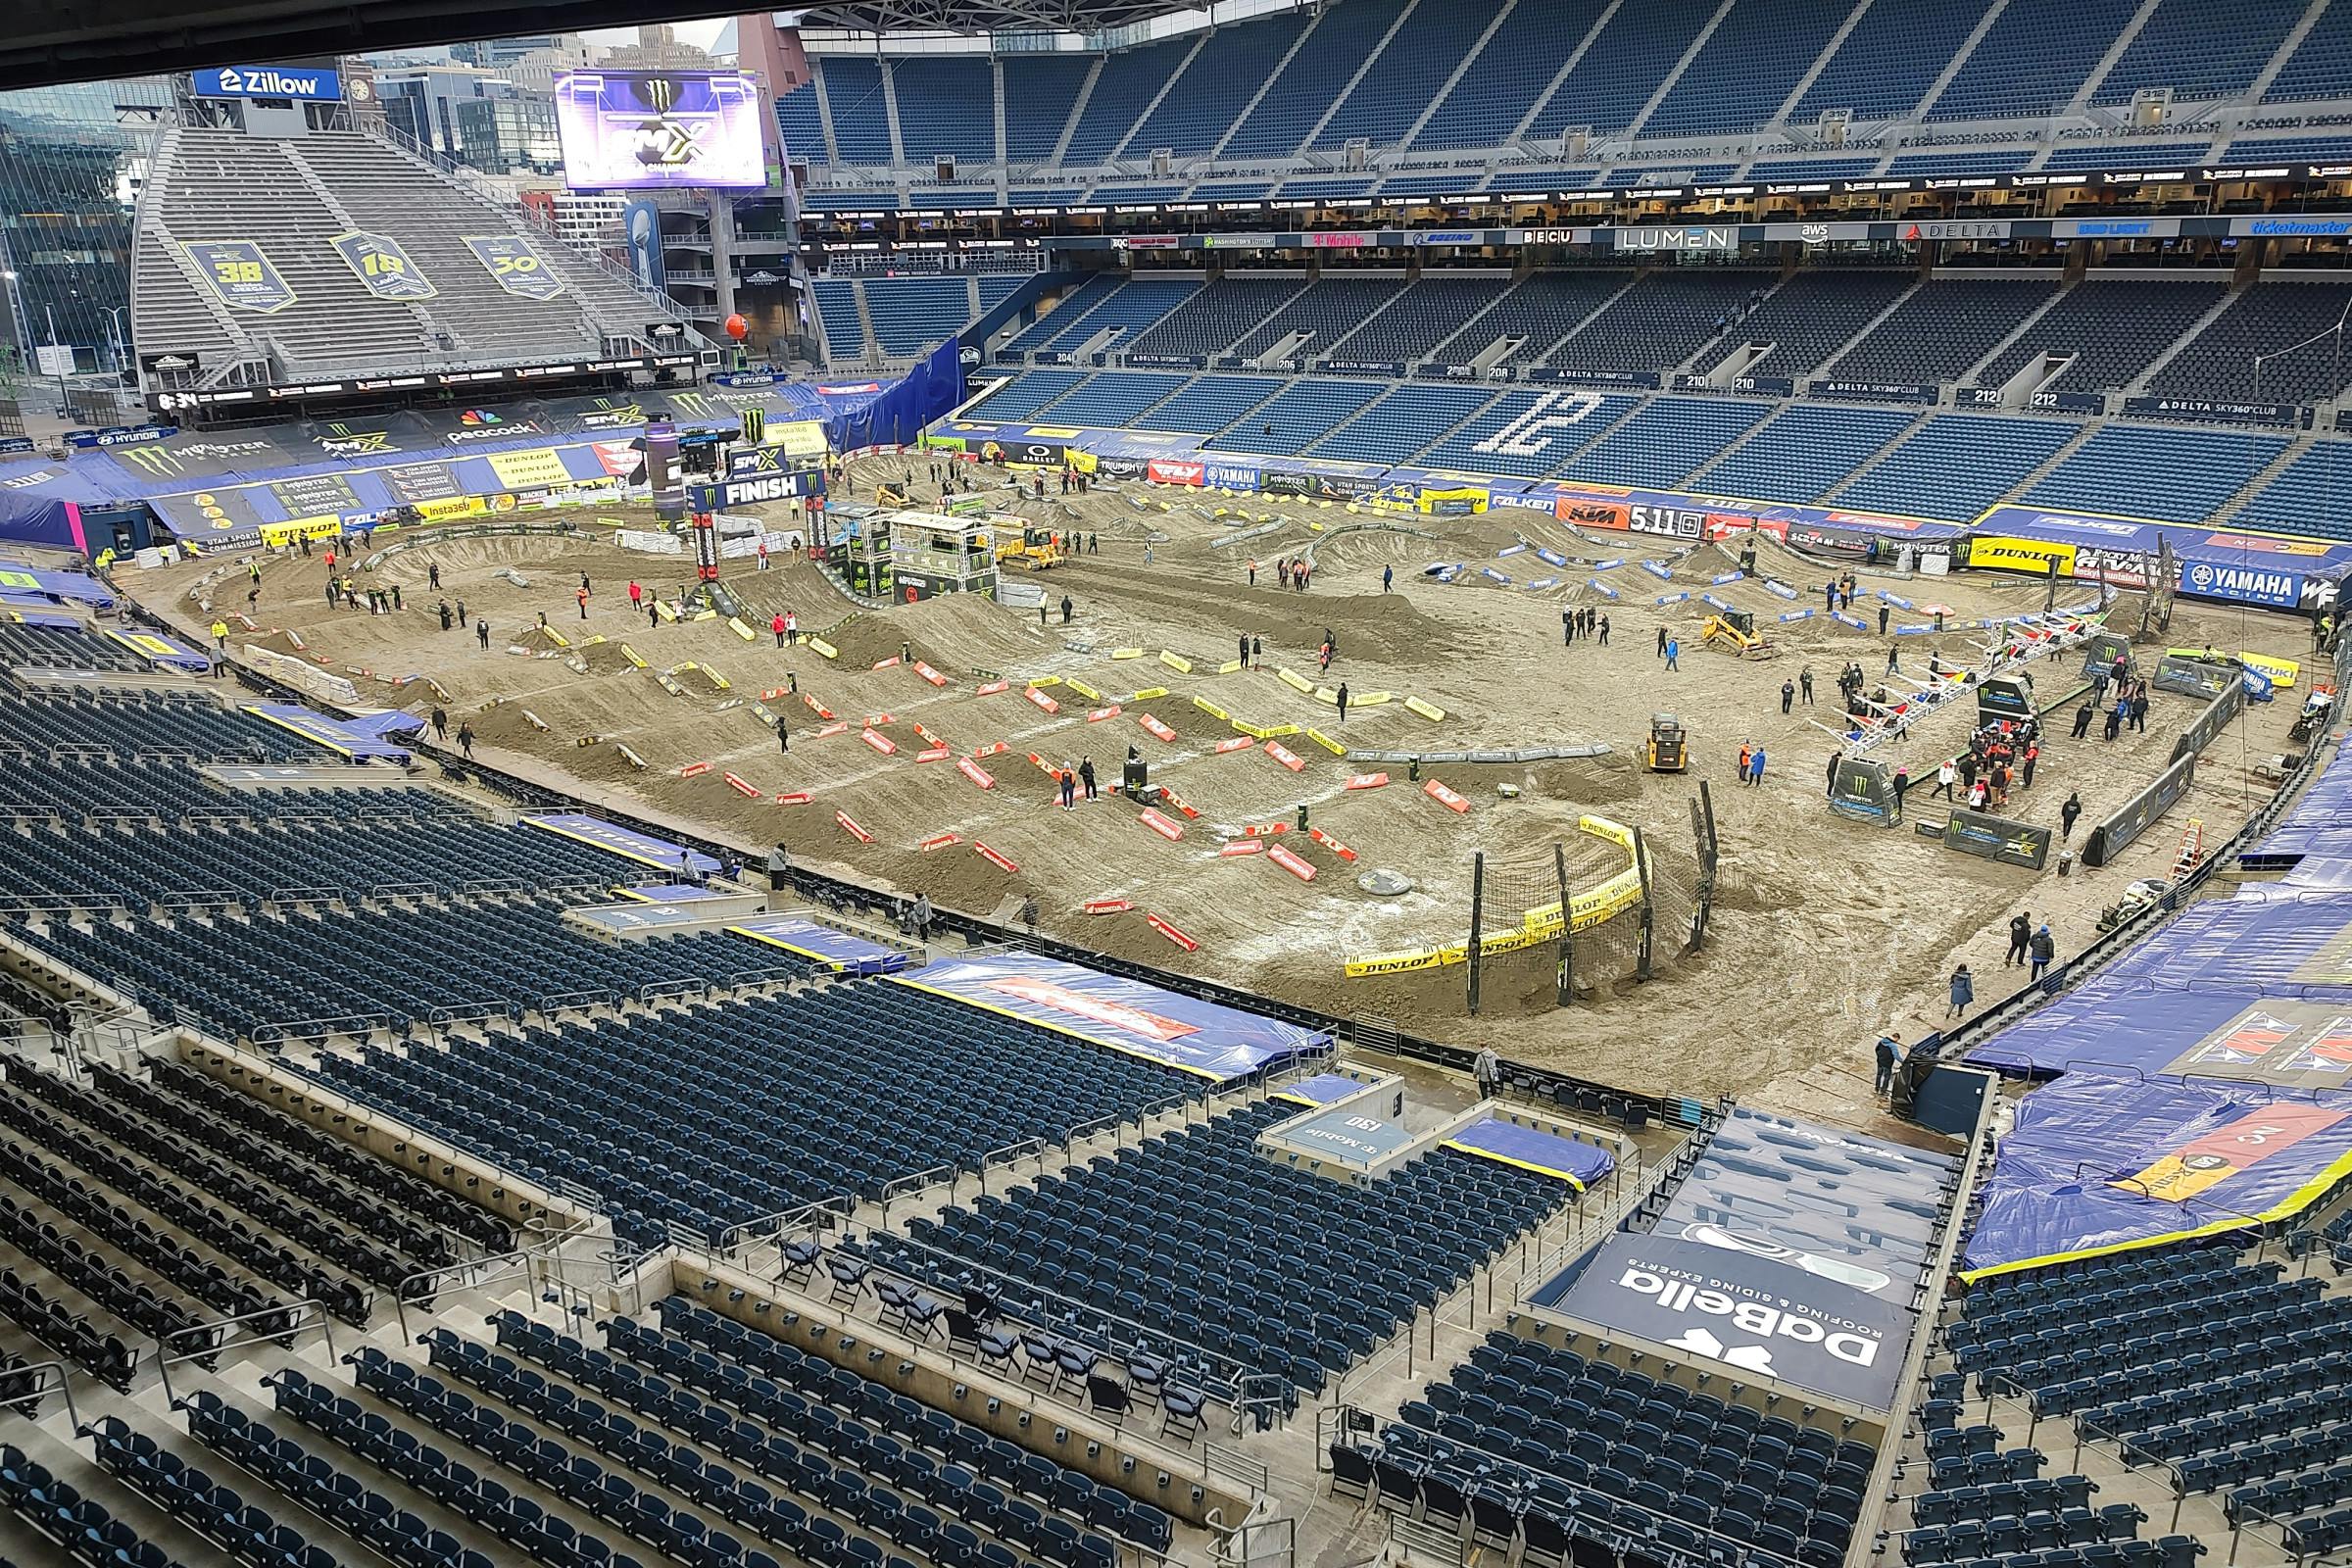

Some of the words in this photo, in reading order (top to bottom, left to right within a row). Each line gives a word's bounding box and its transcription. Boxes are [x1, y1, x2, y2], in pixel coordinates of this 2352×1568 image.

[243, 71, 317, 95] Zillow
[1801, 224, 1827, 235] aws
[1930, 224, 2000, 236] DELTA
[2251, 220, 2351, 234] ticketmaster
[1623, 229, 1728, 248] LUMEN
[361, 252, 405, 276] 18
[493, 256, 538, 274] 30
[1056, 353, 1071, 362] 204
[1242, 358, 1256, 368] 206
[1687, 376, 1705, 386] 210
[1736, 378, 1754, 389] 210
[706, 392, 768, 404] MONSTER
[1975, 390, 1997, 402] 212
[2034, 393, 2056, 406] 212
[2171, 402, 2211, 411] DELTA
[584, 407, 648, 424] SMX
[1472, 392, 1605, 456] 12
[117, 432, 161, 444] HYUNDAI
[447, 422, 535, 444] peacock
[172, 441, 272, 458] MONSTER
[505, 453, 552, 464] DUNLOP
[733, 448, 781, 472] SMX
[1022, 455, 1056, 464] OAKLEY
[511, 464, 559, 474] DUNLOP
[1101, 461, 1135, 472] TRIUMPH
[1152, 464, 1201, 478] FLY
[517, 473, 565, 484] DUNLOP
[1218, 467, 1256, 485] YAMAHA
[1270, 475, 1306, 486] MONSTER
[285, 478, 332, 489] MONSTER
[726, 476, 798, 505] FINISH
[1354, 482, 1377, 491] SPORTS
[294, 490, 340, 501] MONSTER
[301, 501, 349, 512] MONSTER
[1492, 495, 1555, 511] FALKEN
[1568, 507, 1617, 525] KTM
[1630, 505, 1677, 535] 5.11
[2041, 516, 2138, 534] FALKEN
[208, 535, 229, 545] UTAH
[231, 531, 260, 542] SPORTS
[209, 540, 261, 553] COMMISSION
[1892, 543, 1951, 555] MONSTER
[1990, 548, 2070, 563] DUNLOP
[2215, 569, 2293, 597] YAMAHA
[2196, 584, 2286, 603] RACING
[1197, 699, 1222, 716] Insta360
[869, 715, 883, 724] FLY
[1236, 723, 1261, 736] Insta360
[1311, 730, 1339, 752] Insta360
[982, 744, 997, 755] FLY
[1254, 824, 1276, 834] FLY
[1588, 824, 1620, 841] DUNLOP
[1322, 835, 1343, 851] FLY
[1095, 905, 1121, 913] HONDA
[1157, 926, 1191, 950] HONDA
[1365, 957, 1435, 976] DUNLOP
[1343, 1116, 1383, 1132] 130
[1627, 1258, 1704, 1284] EXPERTS
[1708, 1278, 1774, 1301] SIDING
[1778, 1297, 1792, 1307] &
[1618, 1266, 1881, 1368] DaBella
[1795, 1303, 1884, 1339] ROOFING
